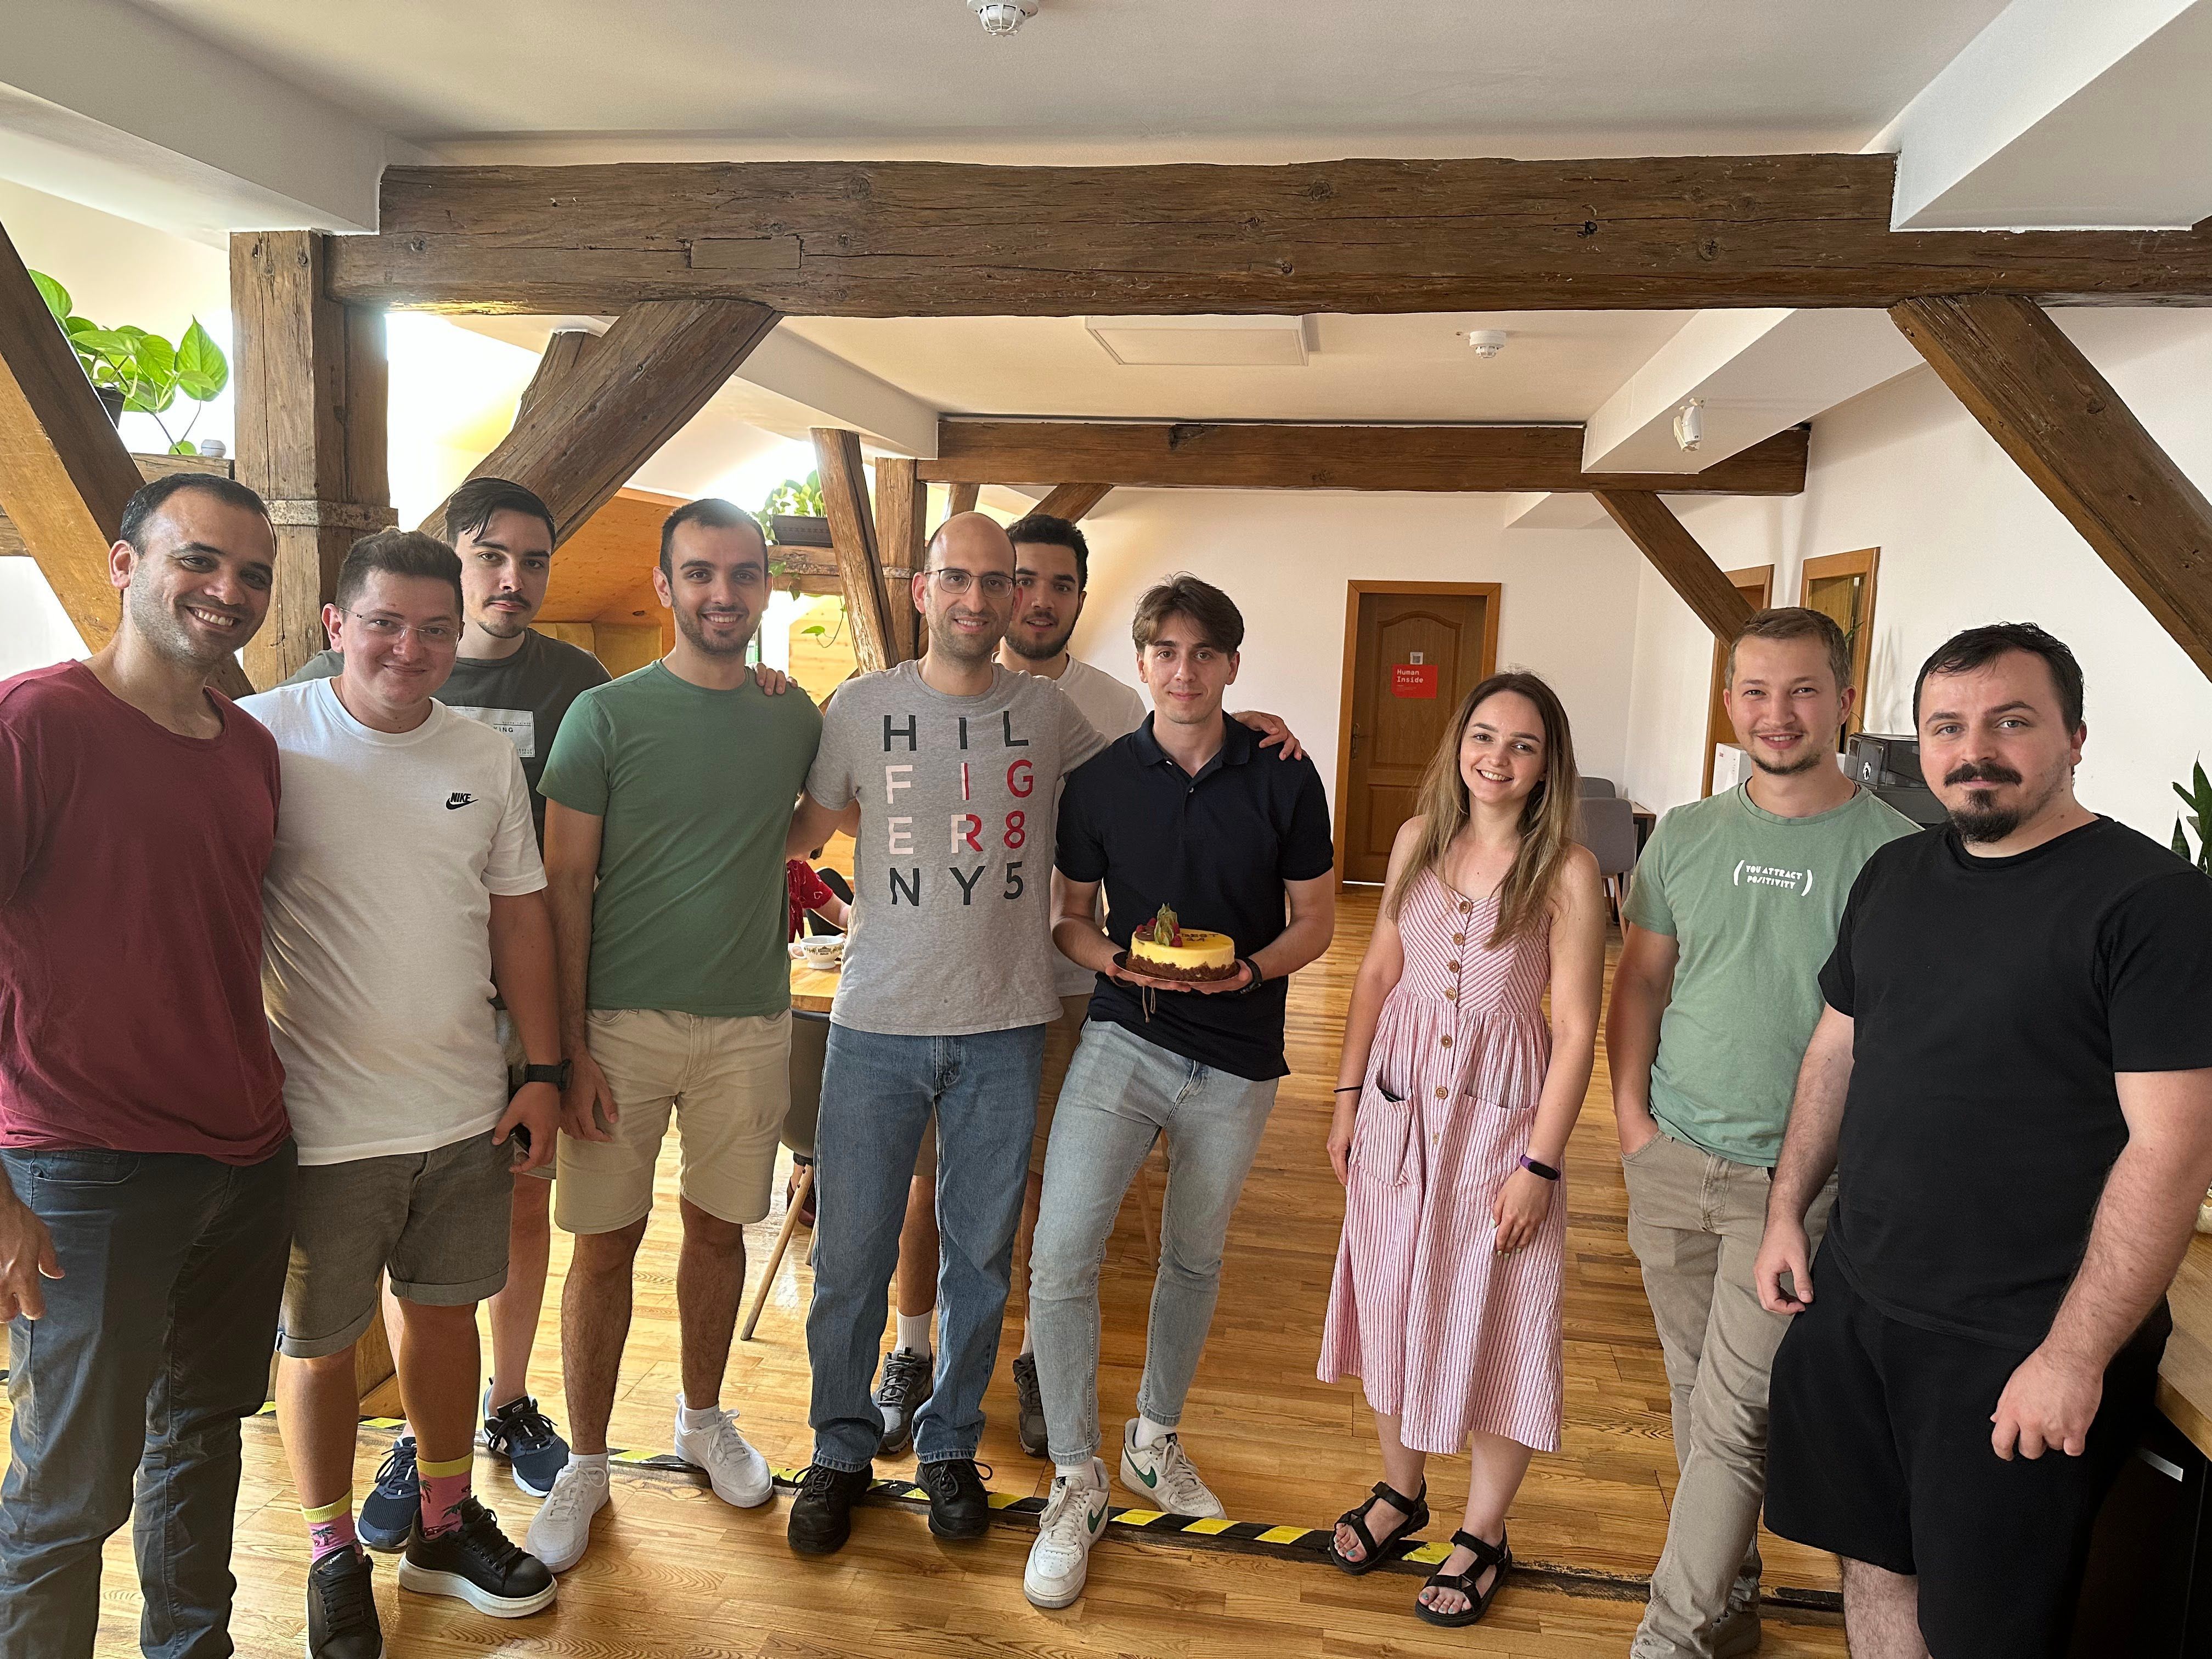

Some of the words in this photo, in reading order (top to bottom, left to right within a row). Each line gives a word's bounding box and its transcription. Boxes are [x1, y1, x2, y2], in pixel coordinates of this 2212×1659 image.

[450, 792, 472, 802] NIKE
[1746, 865, 1761, 873] YOU
[1762, 867, 1803, 880] ATTRACT
[1747, 875, 1796, 889] POSITIVITY
